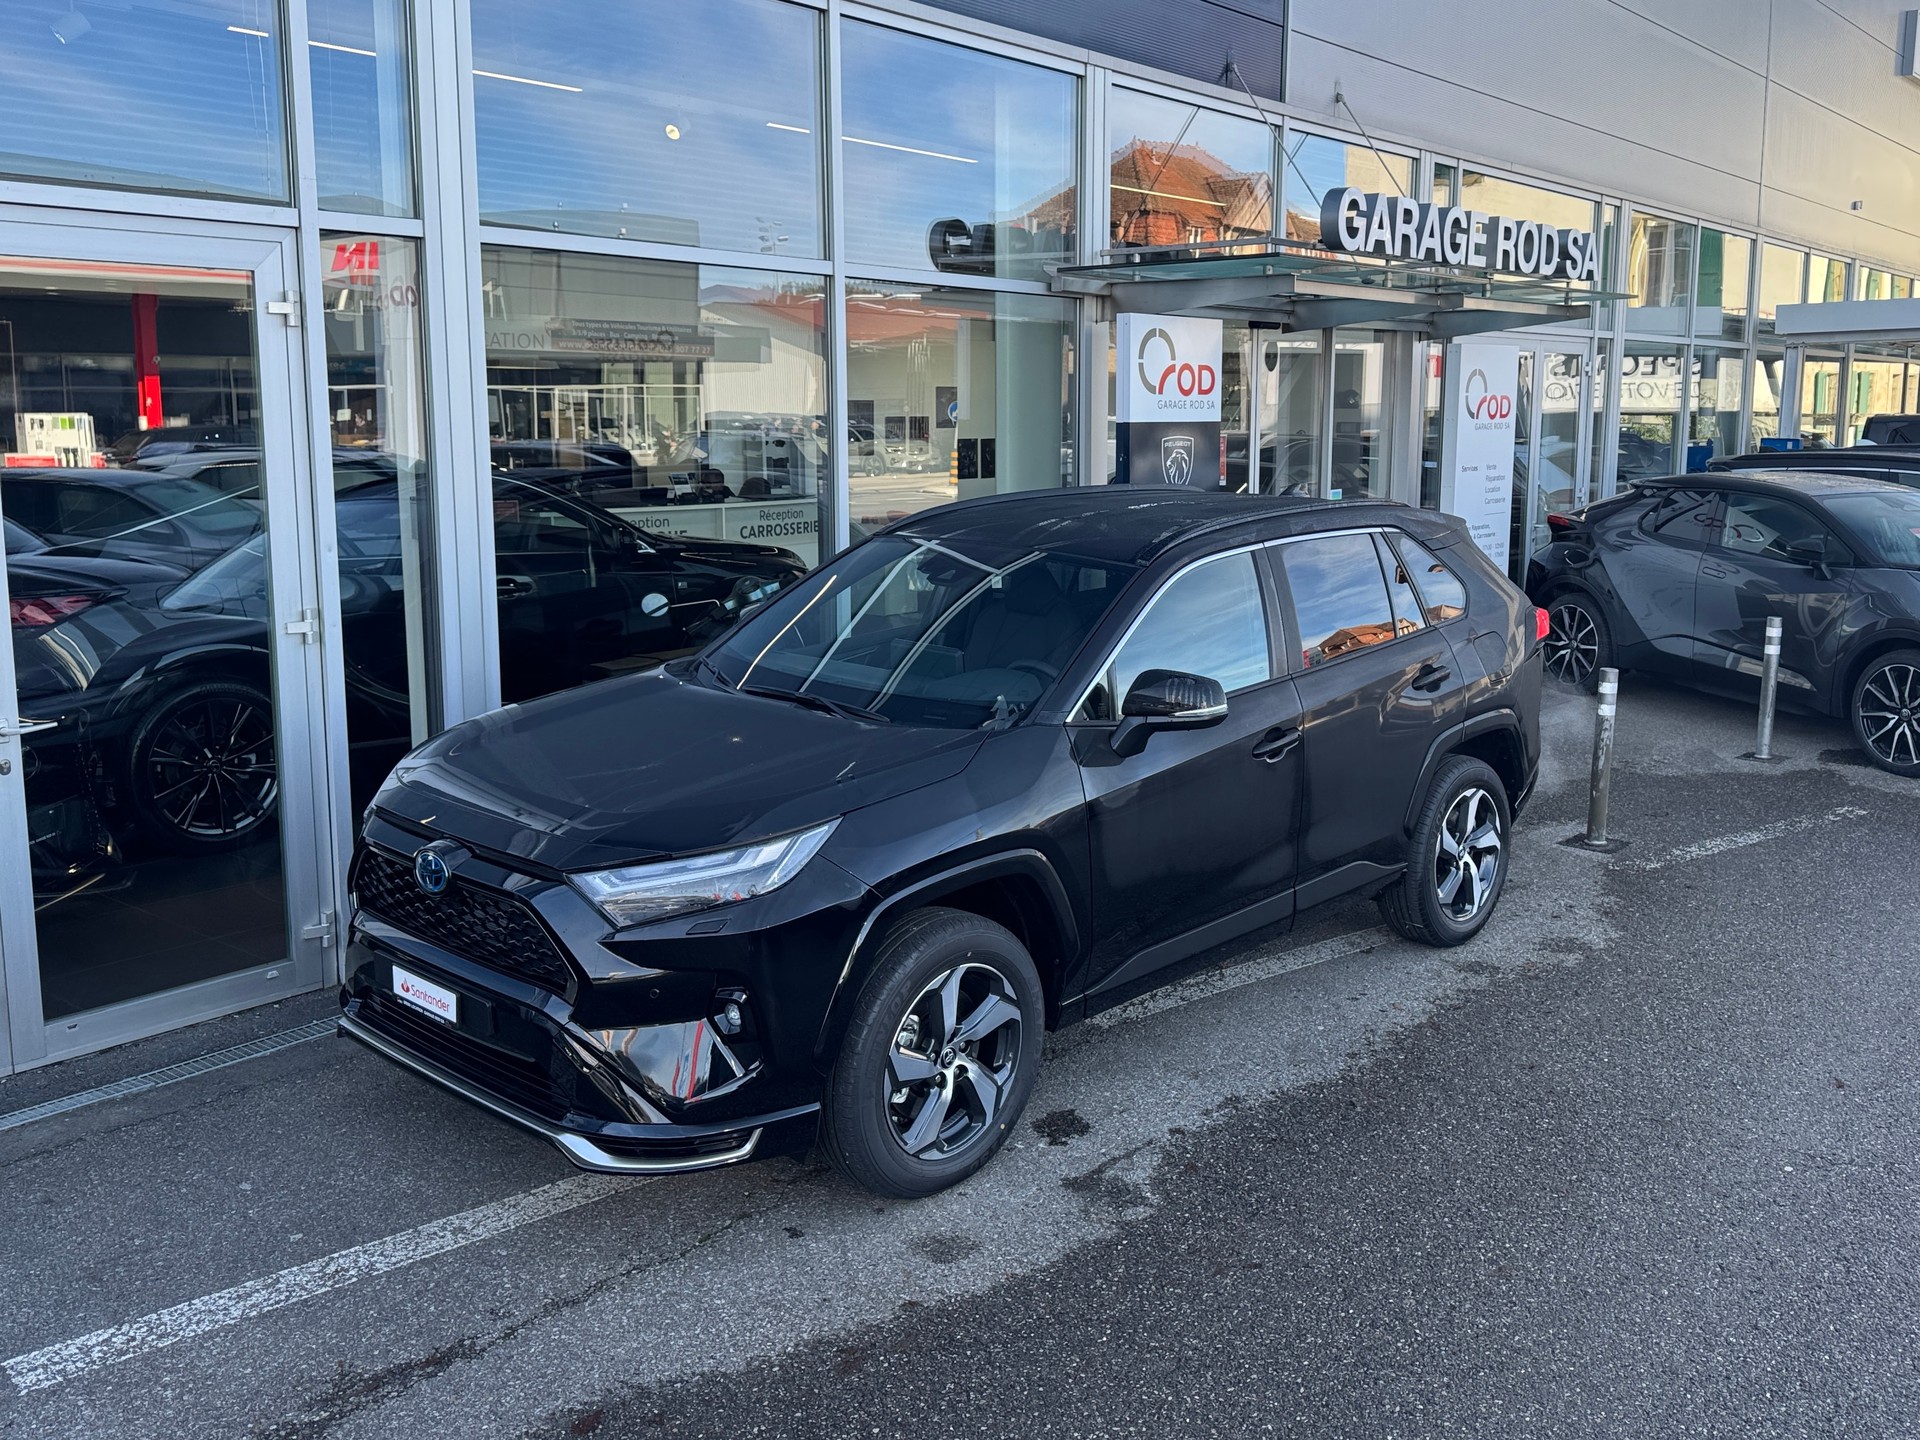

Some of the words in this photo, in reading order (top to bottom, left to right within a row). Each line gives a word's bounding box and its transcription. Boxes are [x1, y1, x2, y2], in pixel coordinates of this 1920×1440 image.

[1337, 187, 1490, 268] GARAGE
[1496, 216, 1560, 276] ROD
[1565, 229, 1600, 282] SA
[586, 321, 601, 331] types
[485, 332, 545, 349] ATION
[1157, 400, 1187, 410] GARAGE
[1190, 400, 1205, 410] ROD
[1206, 400, 1216, 410] SA
[1164, 440, 1192, 448] PEUGEOT
[759, 508, 804, 522] Réception
[625, 516, 670, 529] eption
[740, 519, 819, 540] CARROSSERIE
[410, 984, 450, 1013] Santander
